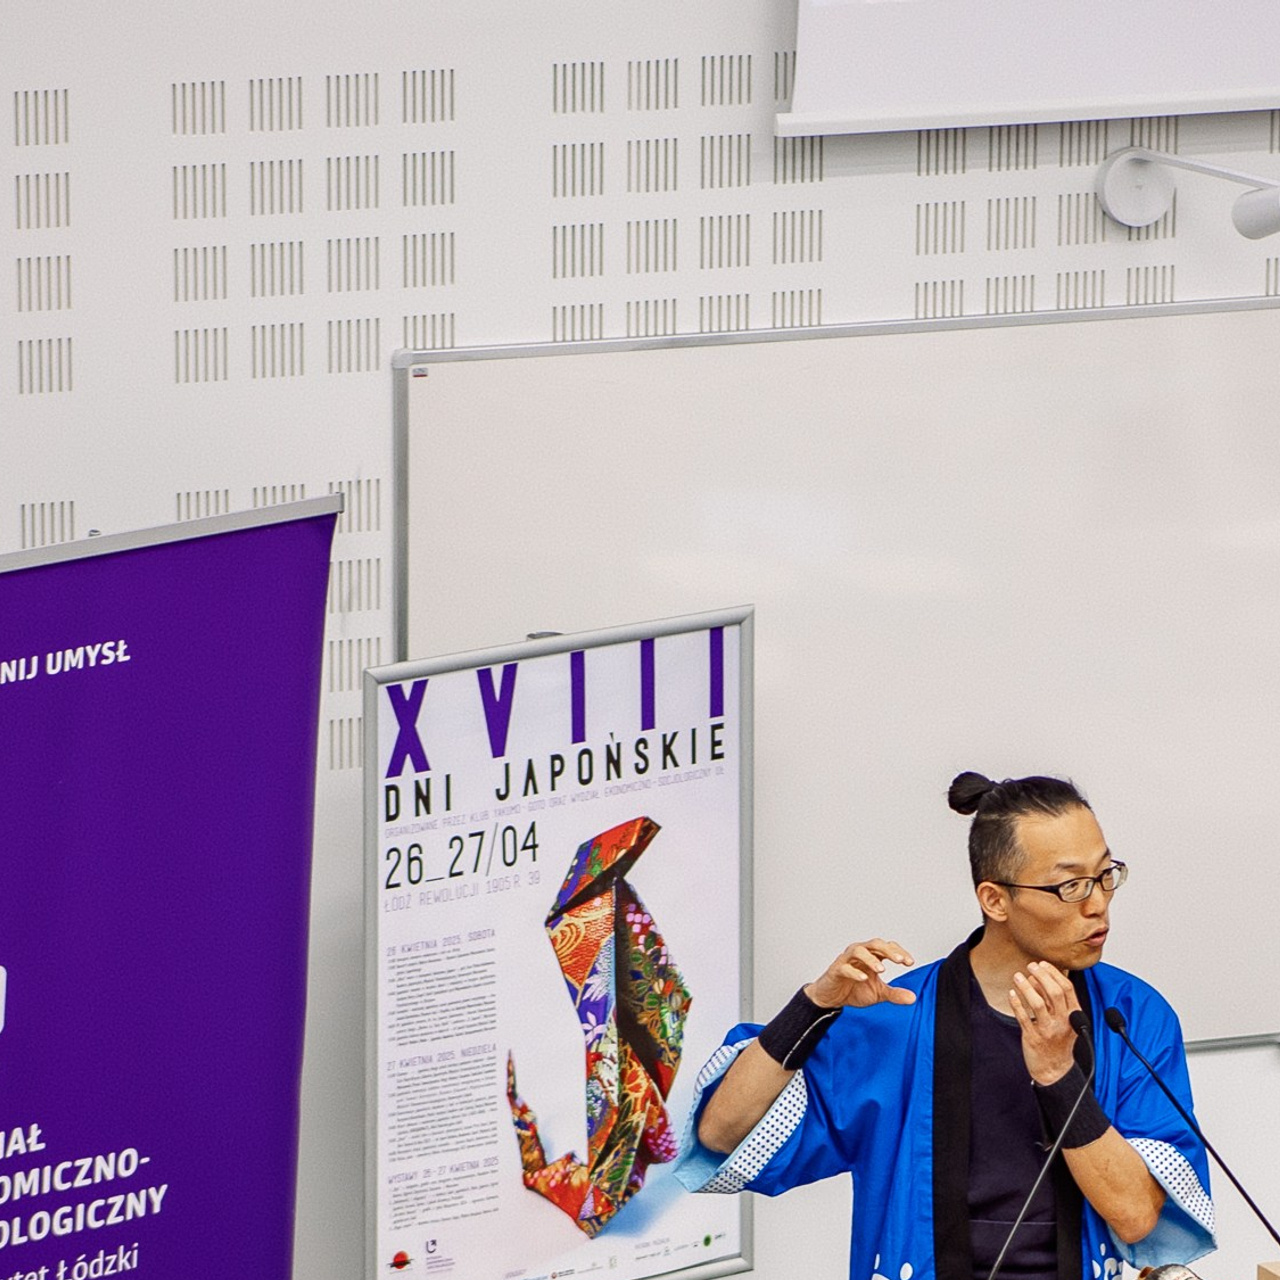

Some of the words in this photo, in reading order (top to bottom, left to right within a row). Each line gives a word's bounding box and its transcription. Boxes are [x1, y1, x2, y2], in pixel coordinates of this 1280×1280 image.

[46, 639, 131, 675] UMYSŁ
[385, 774, 451, 822] DNI
[495, 722, 725, 801] JAPOŃSKIE
[442, 813, 466, 829] PRZEZ
[470, 810, 490, 823] KLUB
[385, 820, 540, 890] 26_27/04
[419, 882, 479, 905] REWOLUCJI
